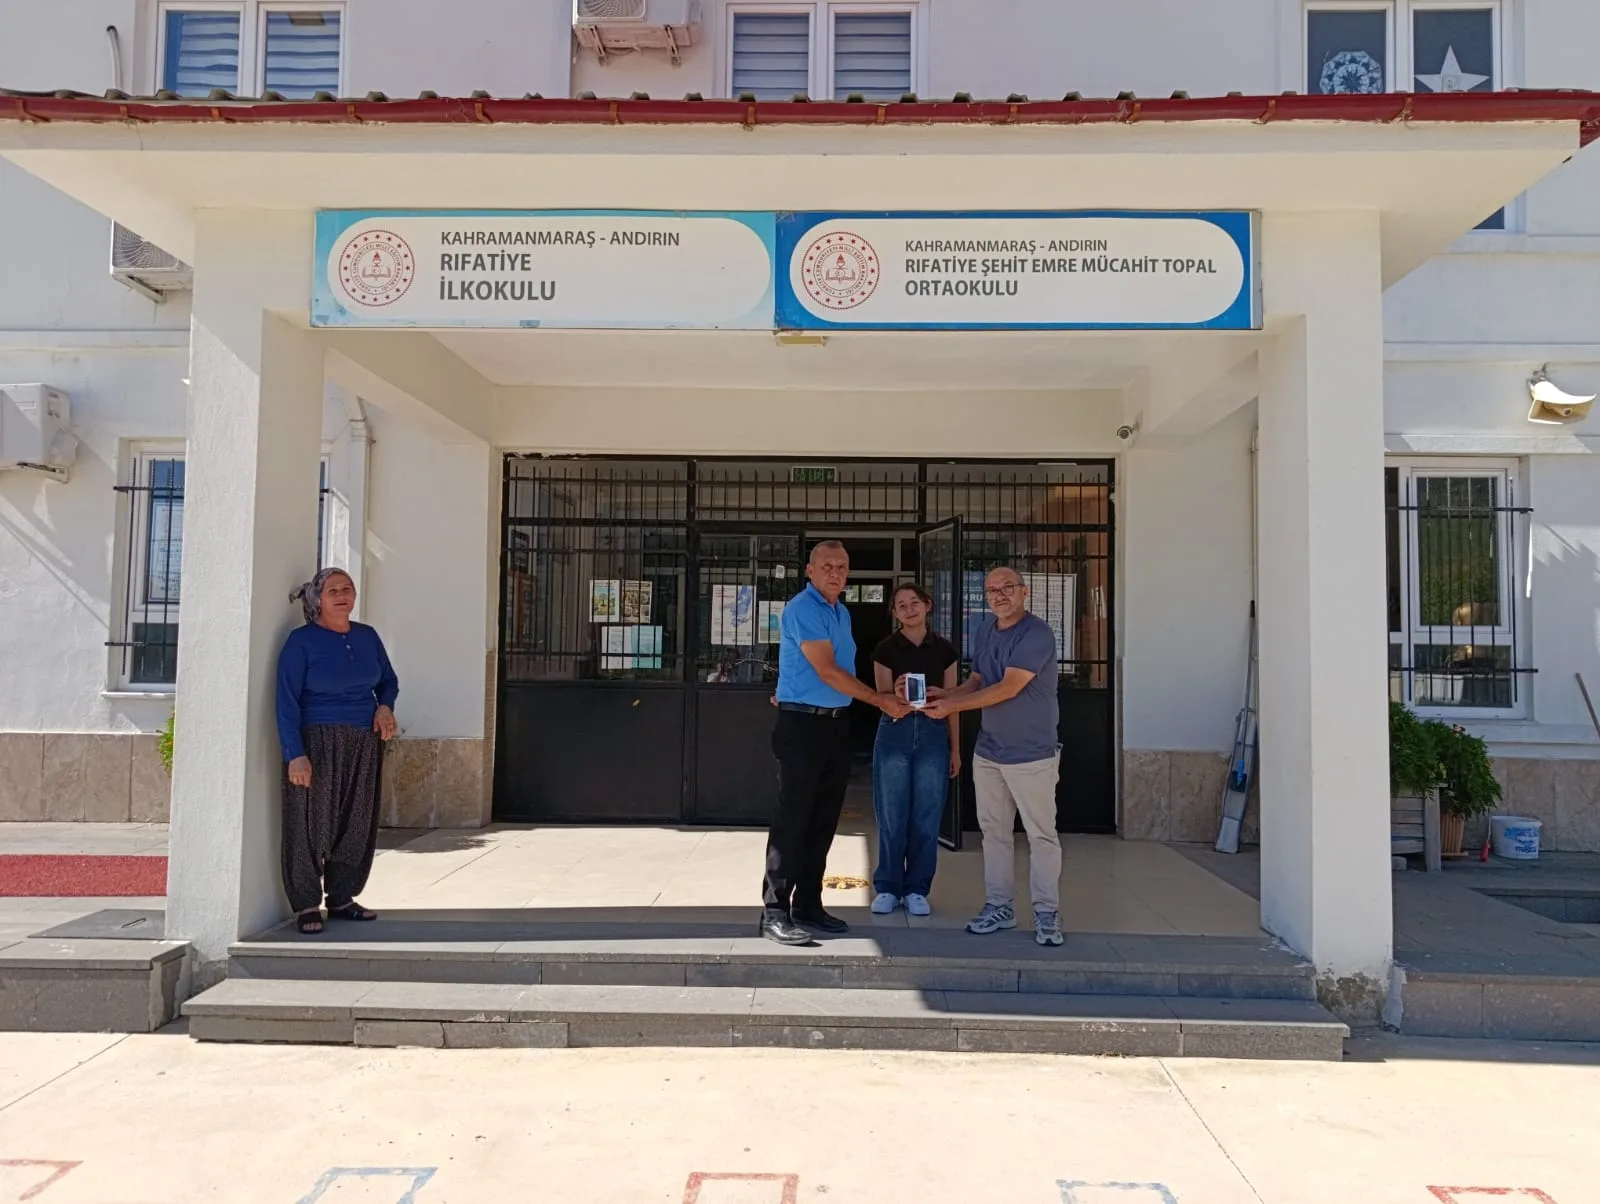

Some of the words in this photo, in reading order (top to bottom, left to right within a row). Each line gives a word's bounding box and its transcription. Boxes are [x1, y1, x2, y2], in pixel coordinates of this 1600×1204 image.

[440, 230, 596, 249] KAHRAMANMARAŞ
[609, 231, 680, 247] ANDIRIN
[905, 240, 1037, 254] KAHRAMANMARAŞ
[1047, 239, 1108, 252] ANDIRIN
[440, 249, 532, 272] RIFATİYE
[905, 256, 977, 273] RIFATİYE
[981, 256, 1029, 277] ŞEHİT
[1031, 258, 1078, 273] EMRE
[1081, 255, 1160, 273] MÜCAHİT
[1161, 258, 1217, 274] TOPAL
[439, 276, 556, 302] İLKOKULU
[905, 279, 1018, 296] ORTAOKULU
